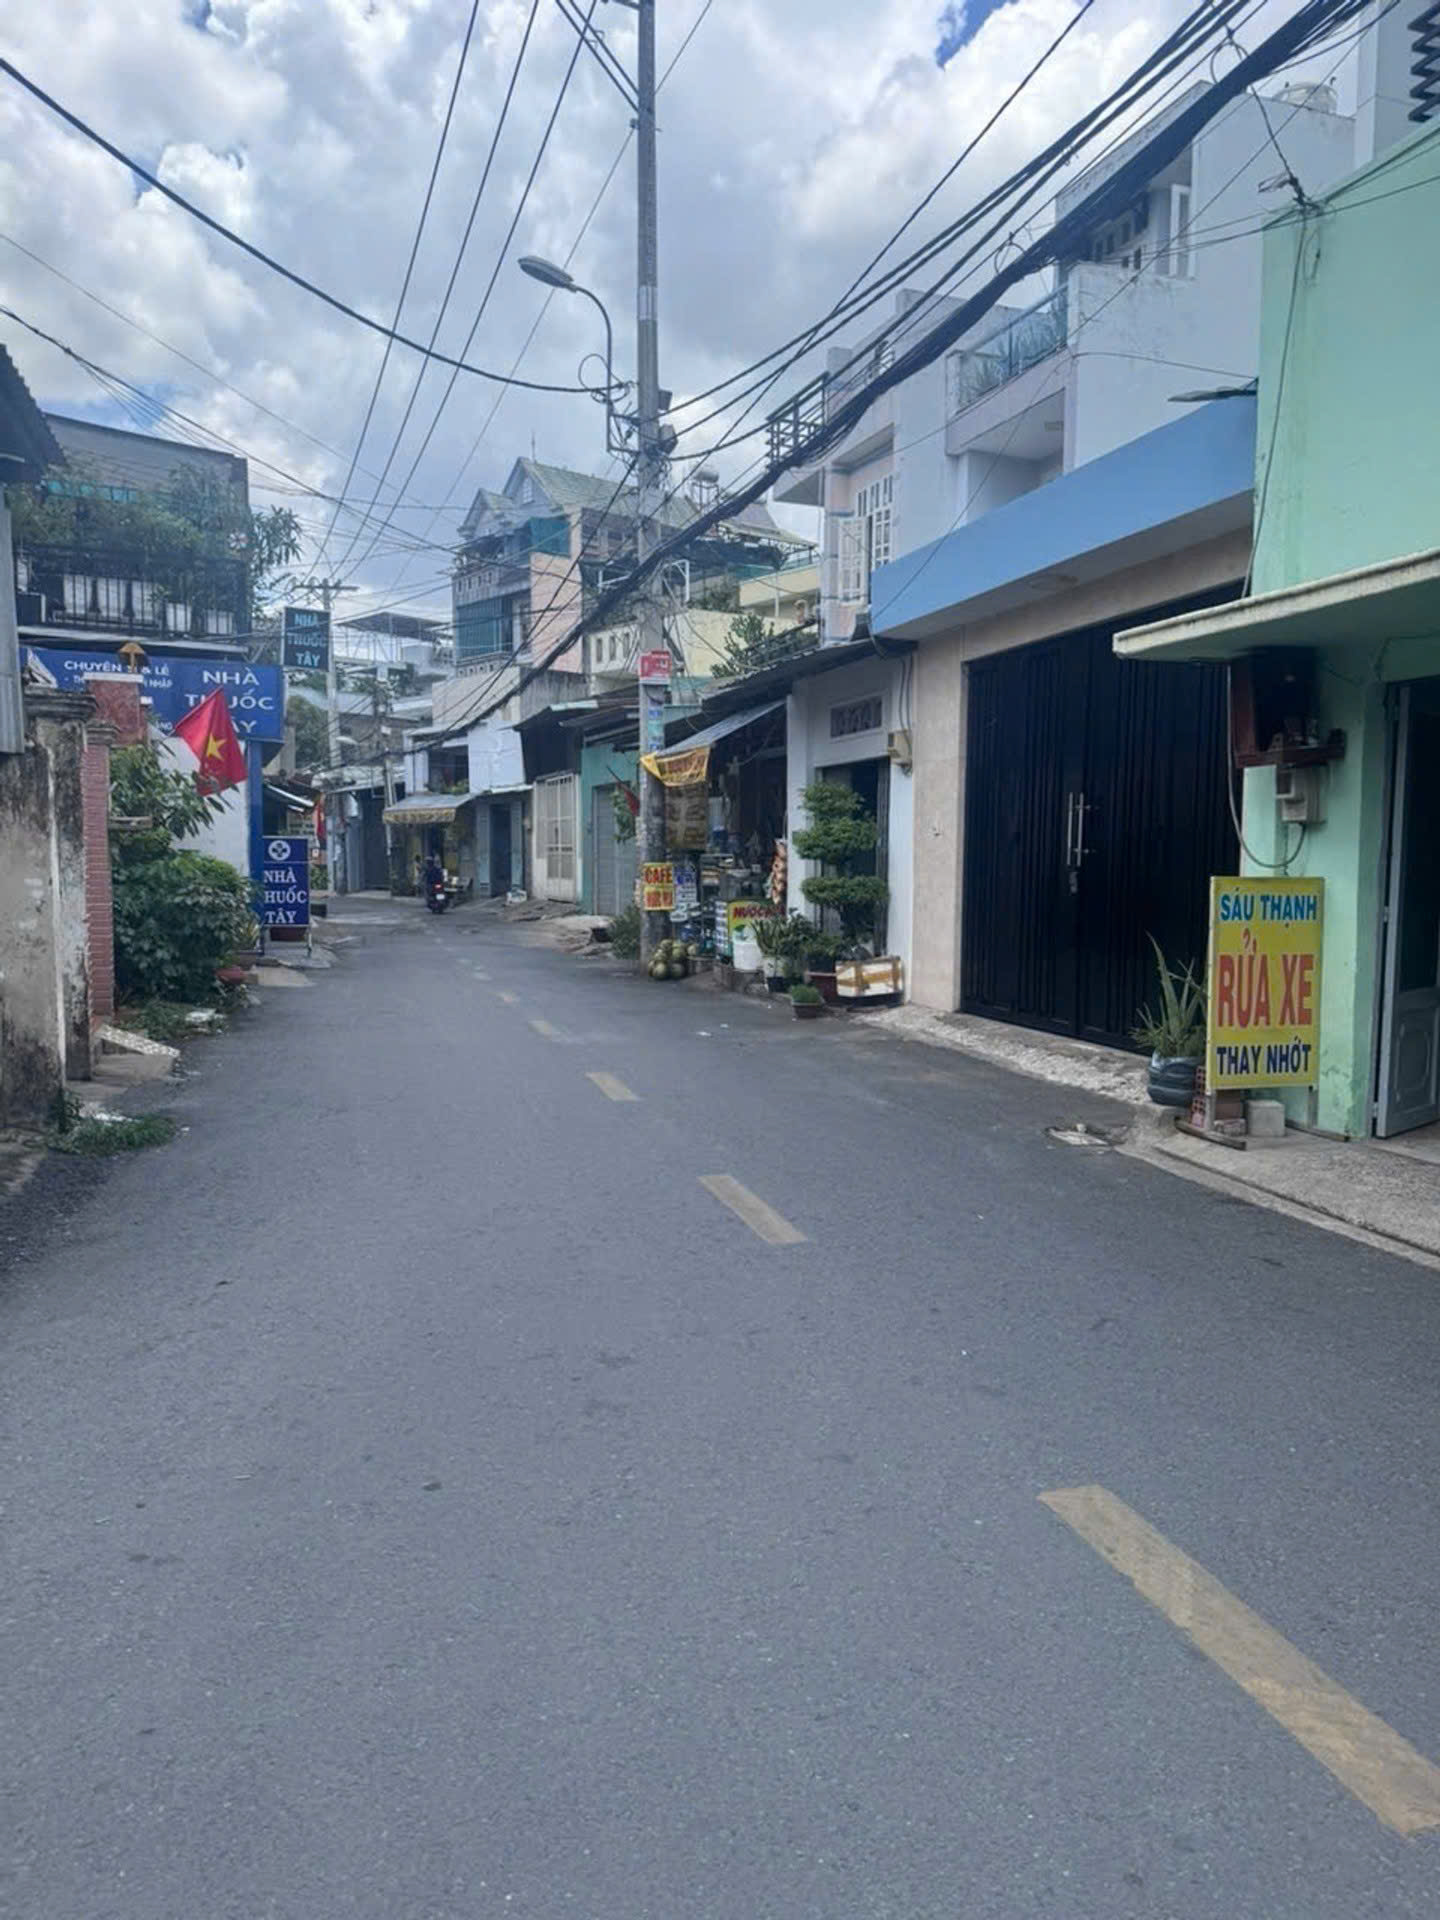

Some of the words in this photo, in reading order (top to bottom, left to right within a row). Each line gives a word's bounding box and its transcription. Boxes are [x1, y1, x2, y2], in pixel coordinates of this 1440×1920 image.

[63, 660, 122, 672] CHUYÊN
[295, 650, 321, 667] TÂY
[202, 666, 260, 686] NHÀ
[263, 866, 297, 883] NHÀ
[263, 884, 308, 904] HUỐC
[264, 907, 297, 924] TÂY
[1219, 886, 1255, 922] SÁU
[1259, 894, 1318, 929] THẠNH
[1217, 927, 1271, 1028] RỬA
[1278, 953, 1314, 1027] XE
[1216, 1045, 1262, 1076] THAY
